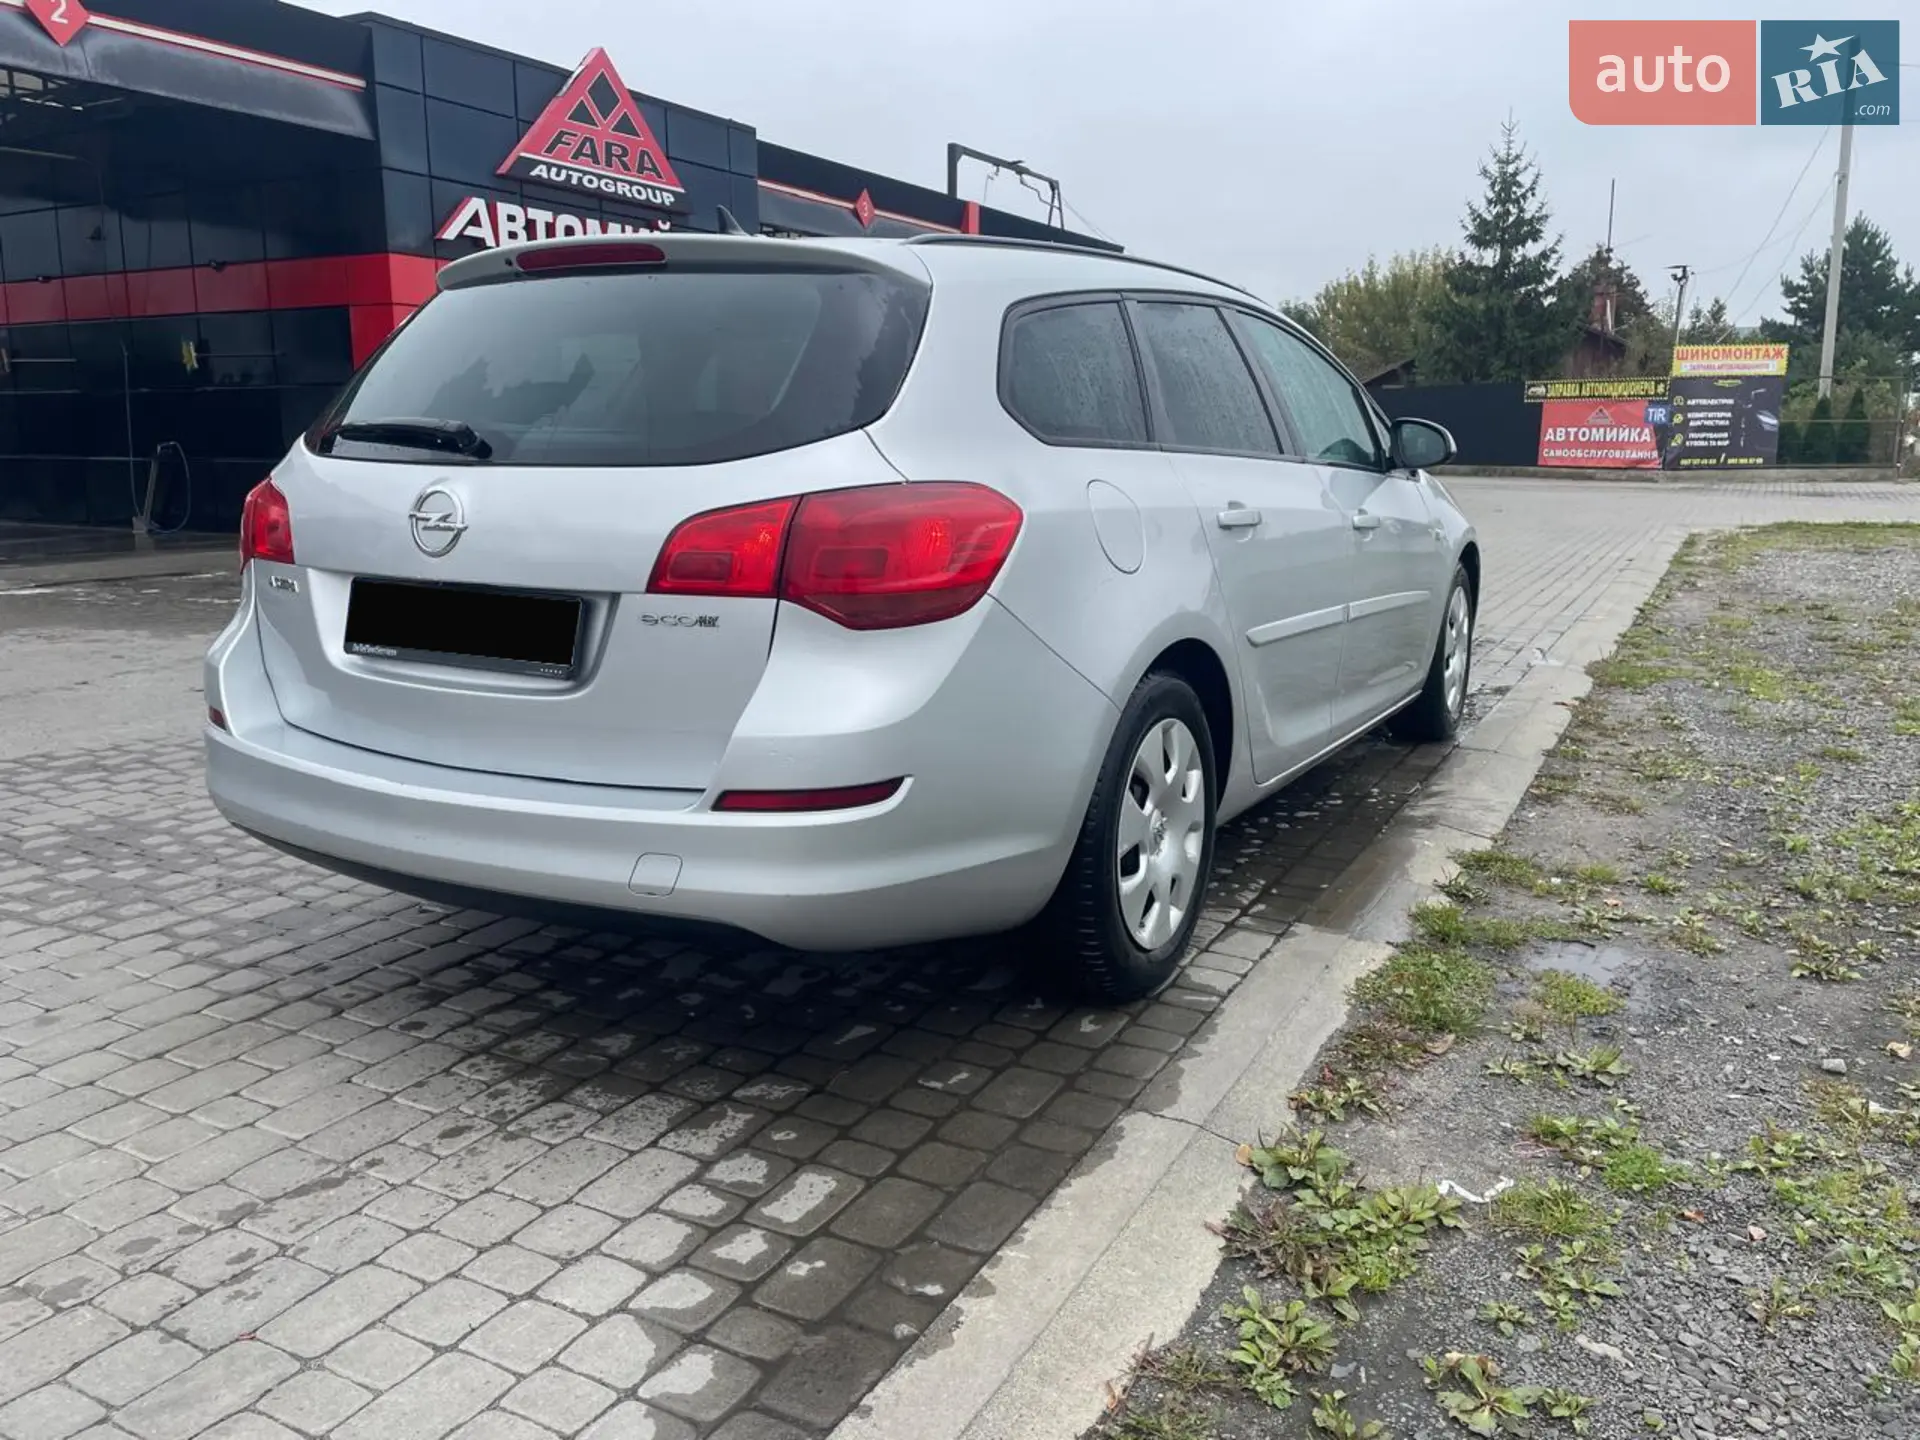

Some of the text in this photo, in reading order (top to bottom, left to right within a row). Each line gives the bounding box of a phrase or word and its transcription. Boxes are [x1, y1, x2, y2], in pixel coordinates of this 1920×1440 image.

[50, 0, 69, 24] 2
[542, 128, 667, 181] FARA
[529, 163, 676, 207] AUTOGROUP
[438, 196, 671, 248] АВТО
[1676, 346, 1785, 361] ШИНОМОНТАЖ
[1547, 383, 1580, 397] ЗАПРАВКА
[1648, 407, 1667, 422] TIR
[1544, 425, 1652, 443] АВТОМИЙКА
